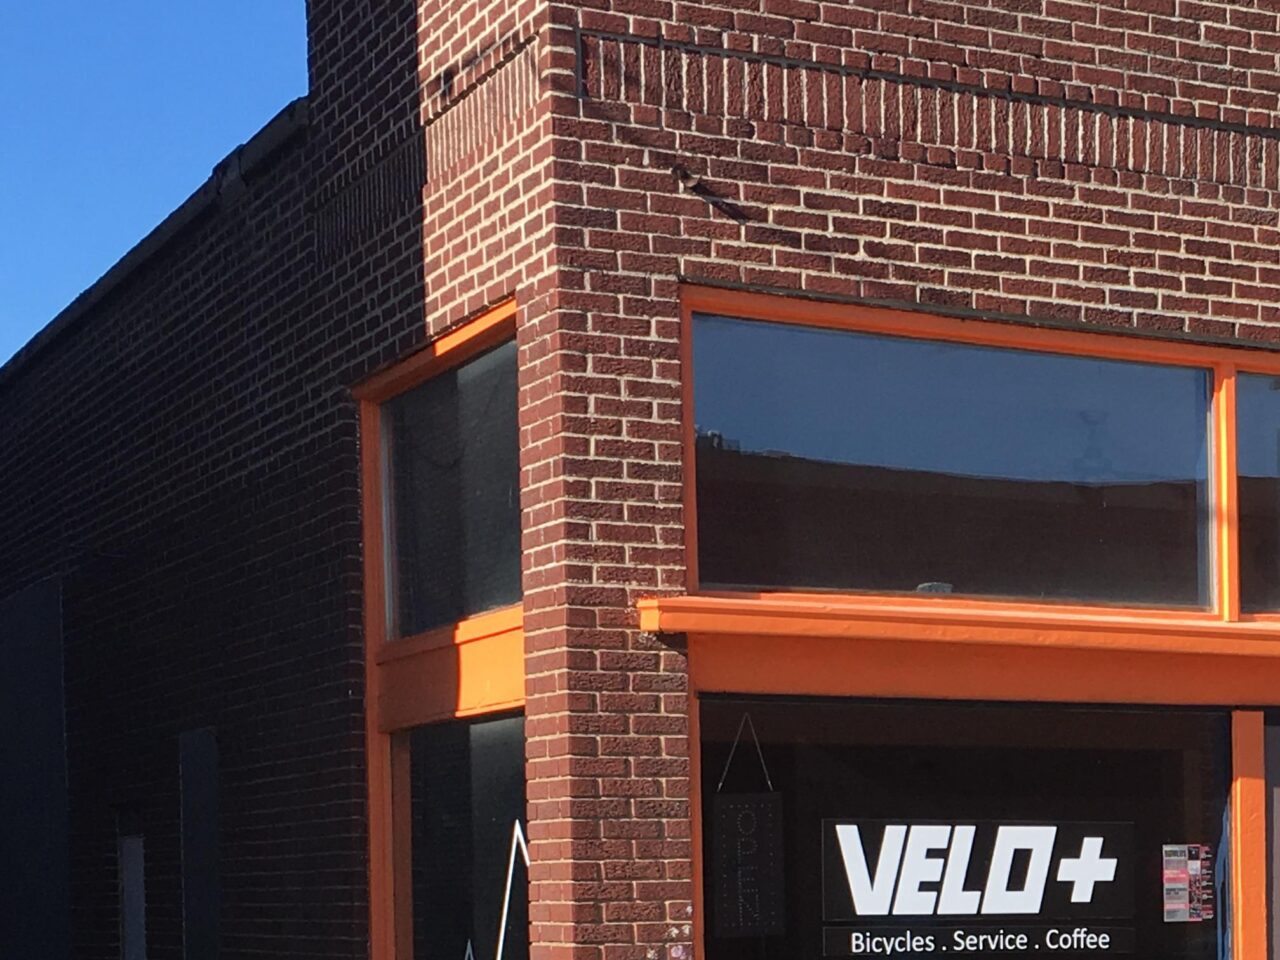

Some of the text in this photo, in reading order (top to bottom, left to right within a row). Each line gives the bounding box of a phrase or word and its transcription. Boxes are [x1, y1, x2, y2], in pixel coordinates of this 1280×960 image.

[835, 824, 1118, 915] VELO+
[851, 931, 935, 955] Bicycles
[953, 929, 1028, 951] Service
[1046, 928, 1110, 950] Coffee
